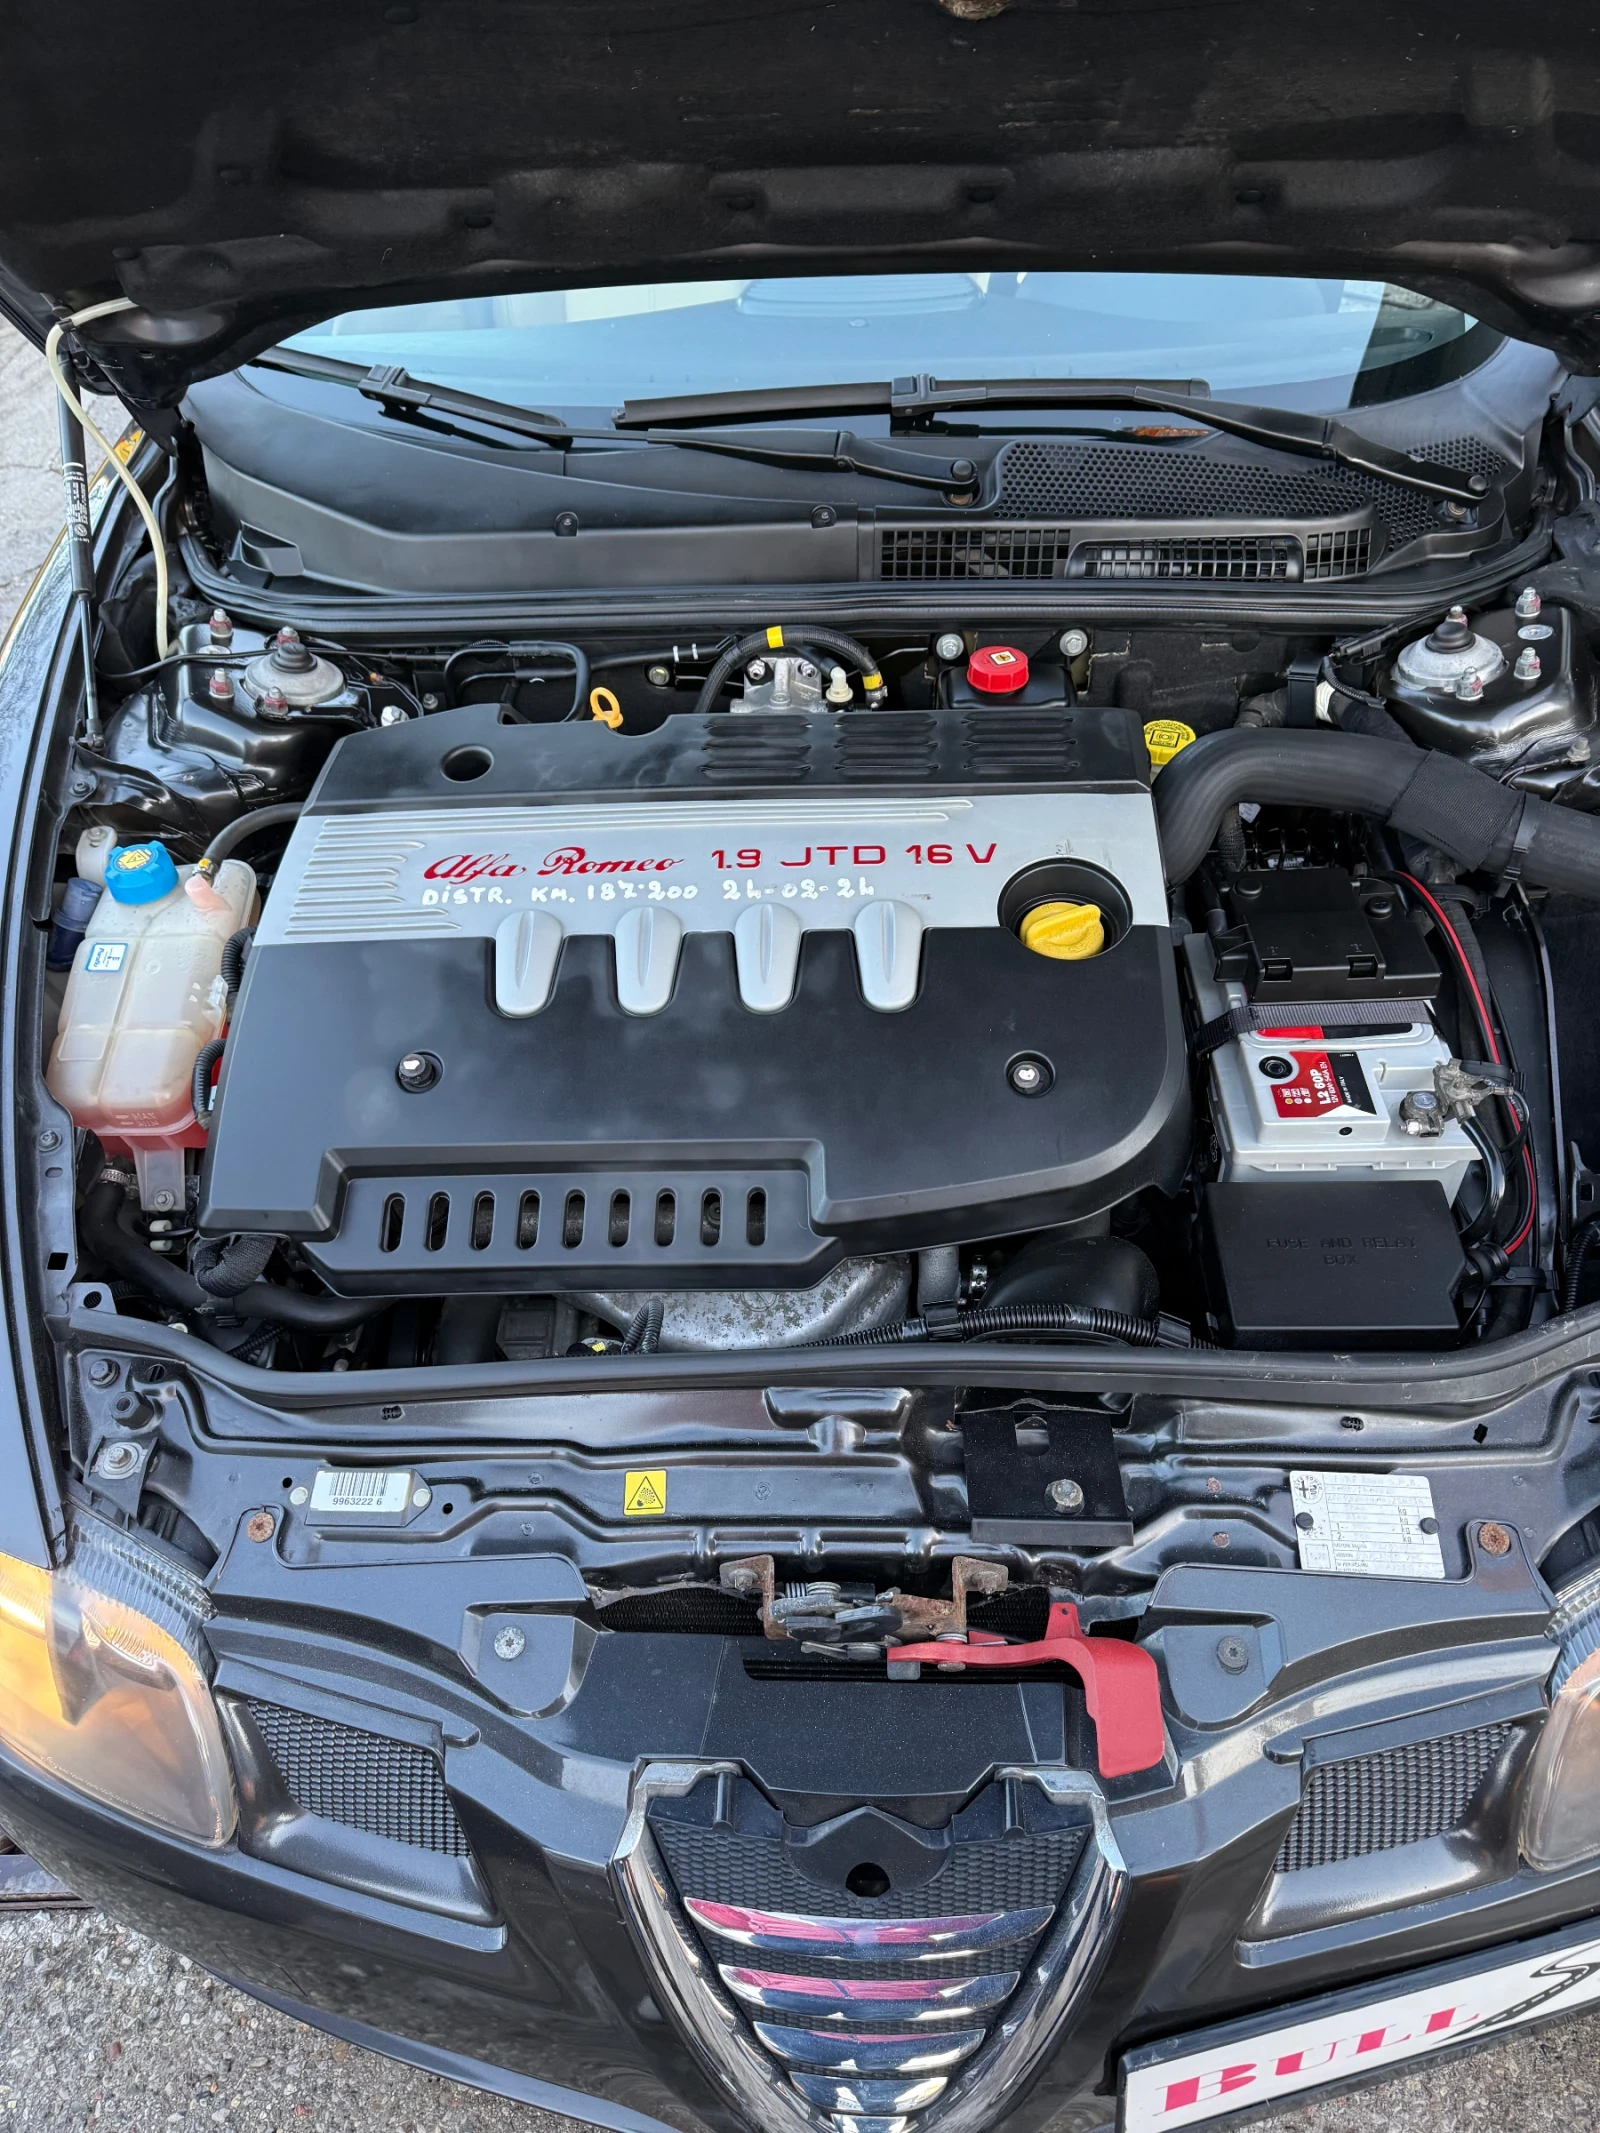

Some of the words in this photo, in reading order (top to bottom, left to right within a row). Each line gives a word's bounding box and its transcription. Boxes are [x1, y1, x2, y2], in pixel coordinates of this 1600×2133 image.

[423, 853, 527, 885] Alfa
[536, 846, 684, 876] Romeo
[711, 848, 762, 869] 1.9
[779, 844, 887, 867] JTD
[904, 843, 953, 866] 16
[965, 843, 997, 865] V
[1309, 1068, 1326, 1090] 60P
[1338, 1075, 1346, 1087] ITALY
[1317, 1090, 1332, 1105] L2
[1343, 1091, 1353, 1103] MADE
[1266, 1237, 1311, 1250] FUSE
[1320, 1236, 1353, 1249] AND
[1362, 1236, 1417, 1249] RELAY
[1323, 1254, 1360, 1266] BOX
[332, 1496, 374, 1506] 9963222
[376, 1497, 383, 1506] 6
[1398, 1506, 1407, 1516] kg
[1400, 1516, 1409, 1525] kg
[1403, 1534, 1412, 1544] kg
[1152, 2004, 1480, 2117] BULL
